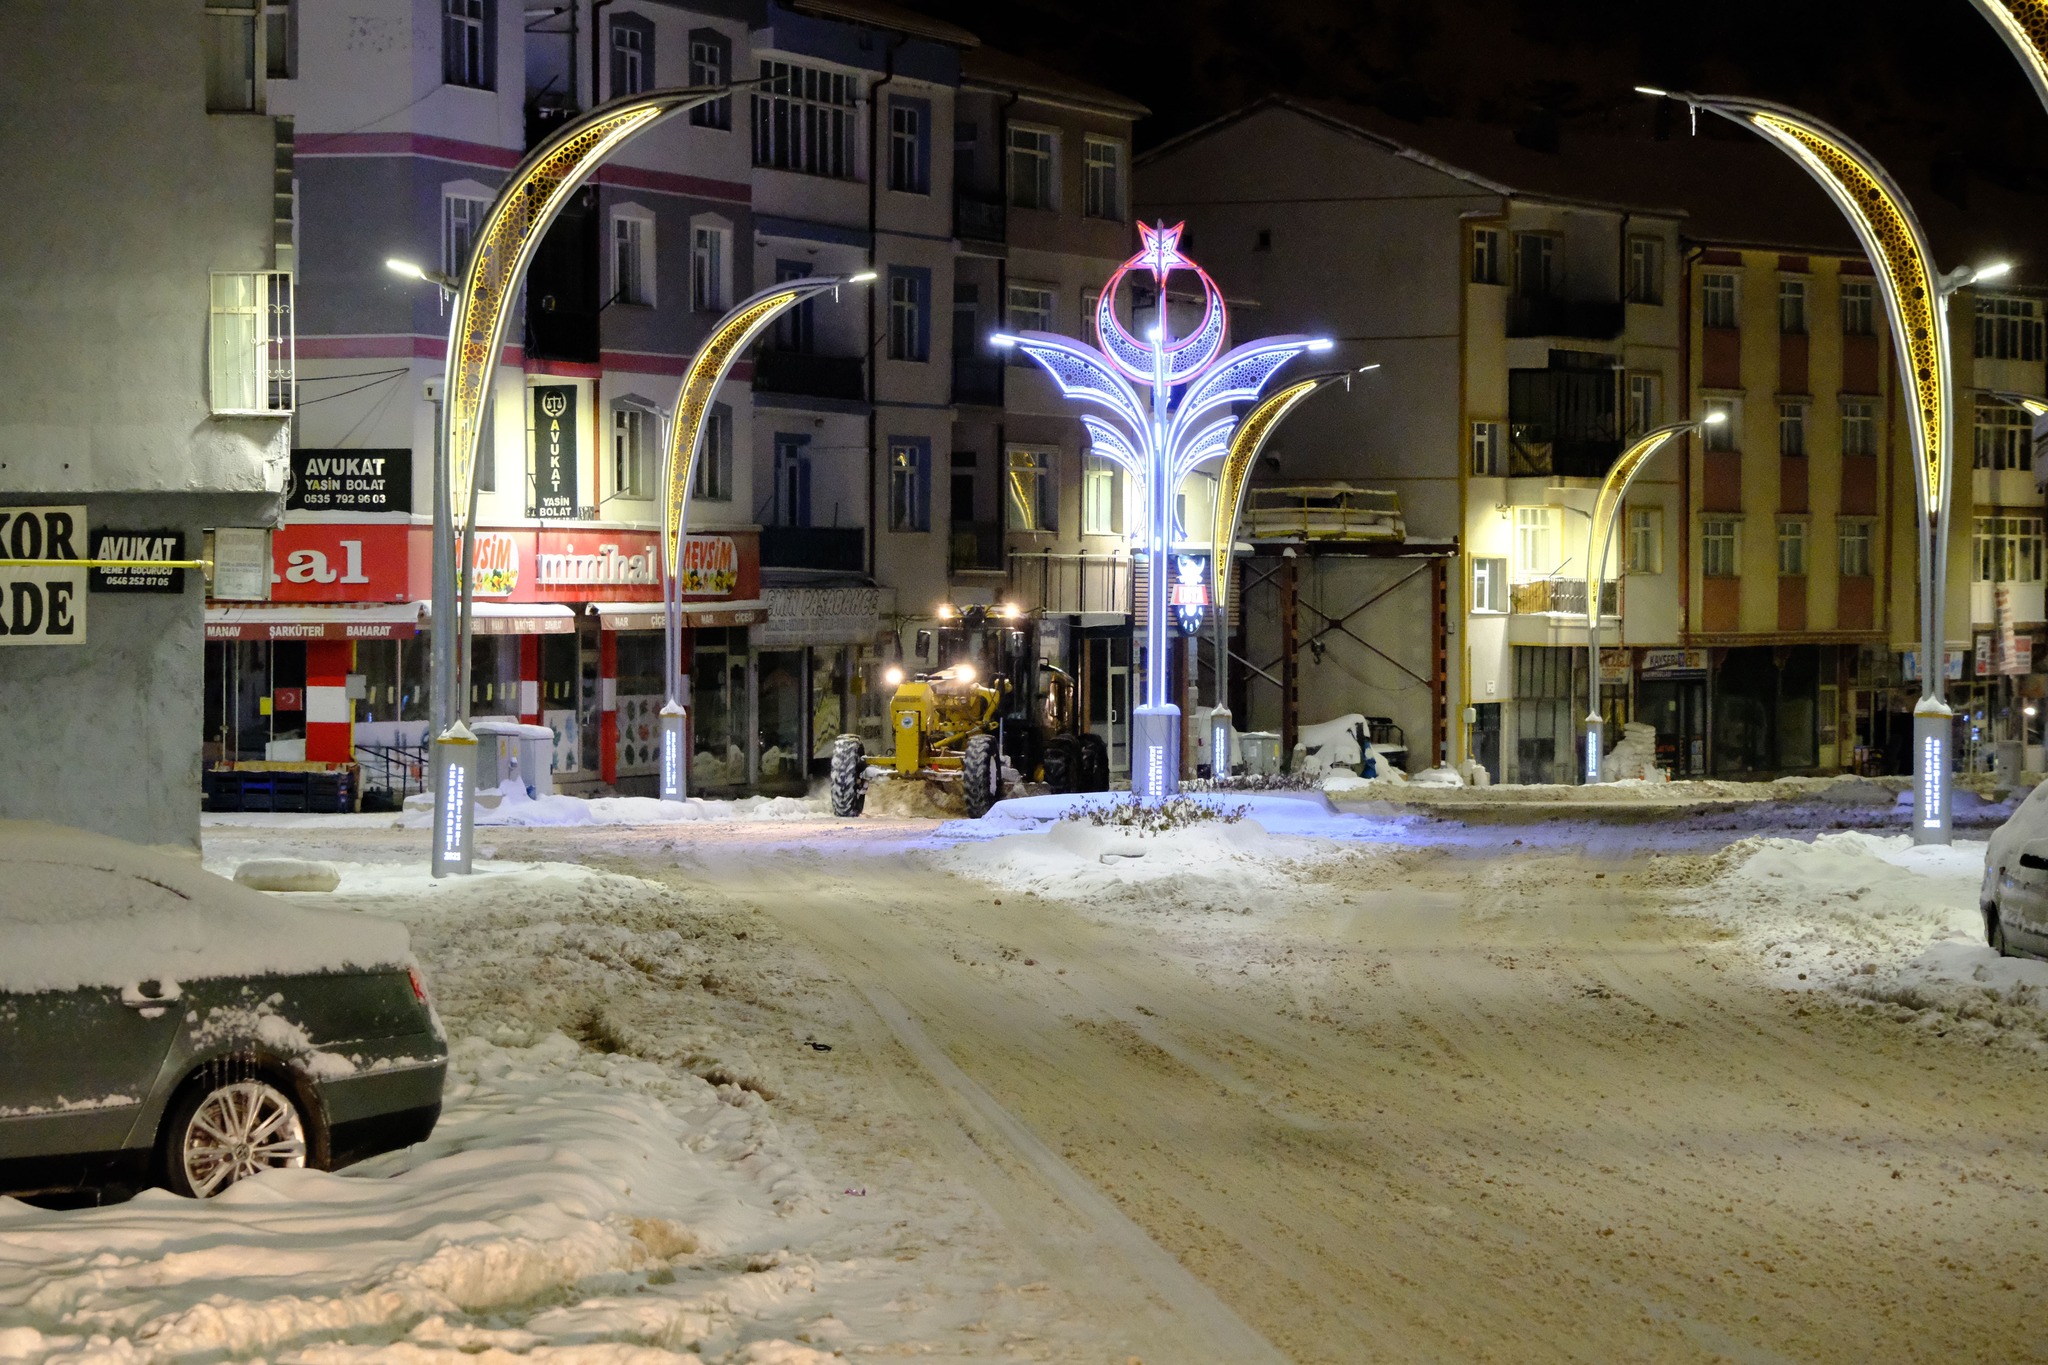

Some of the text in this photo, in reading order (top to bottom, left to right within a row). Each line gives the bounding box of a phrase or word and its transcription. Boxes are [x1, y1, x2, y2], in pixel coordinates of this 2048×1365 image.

[550, 419, 560, 492] AVUKAT
[305, 458, 385, 476] AVUKAT
[305, 477, 386, 490] YASİN BOLAT
[304, 494, 386, 504] 0535 792 96 03
[543, 496, 570, 506] YASİN
[540, 507, 571, 516] BOLAT
[97, 536, 177, 562] AVUKAT
[271, 540, 369, 584] al
[536, 544, 659, 585] minihal
[106, 577, 169, 586] 0546 252 87 05
[0, 581, 74, 635] DE
[207, 626, 241, 637] MANAV
[346, 626, 391, 636] BAHARAT
